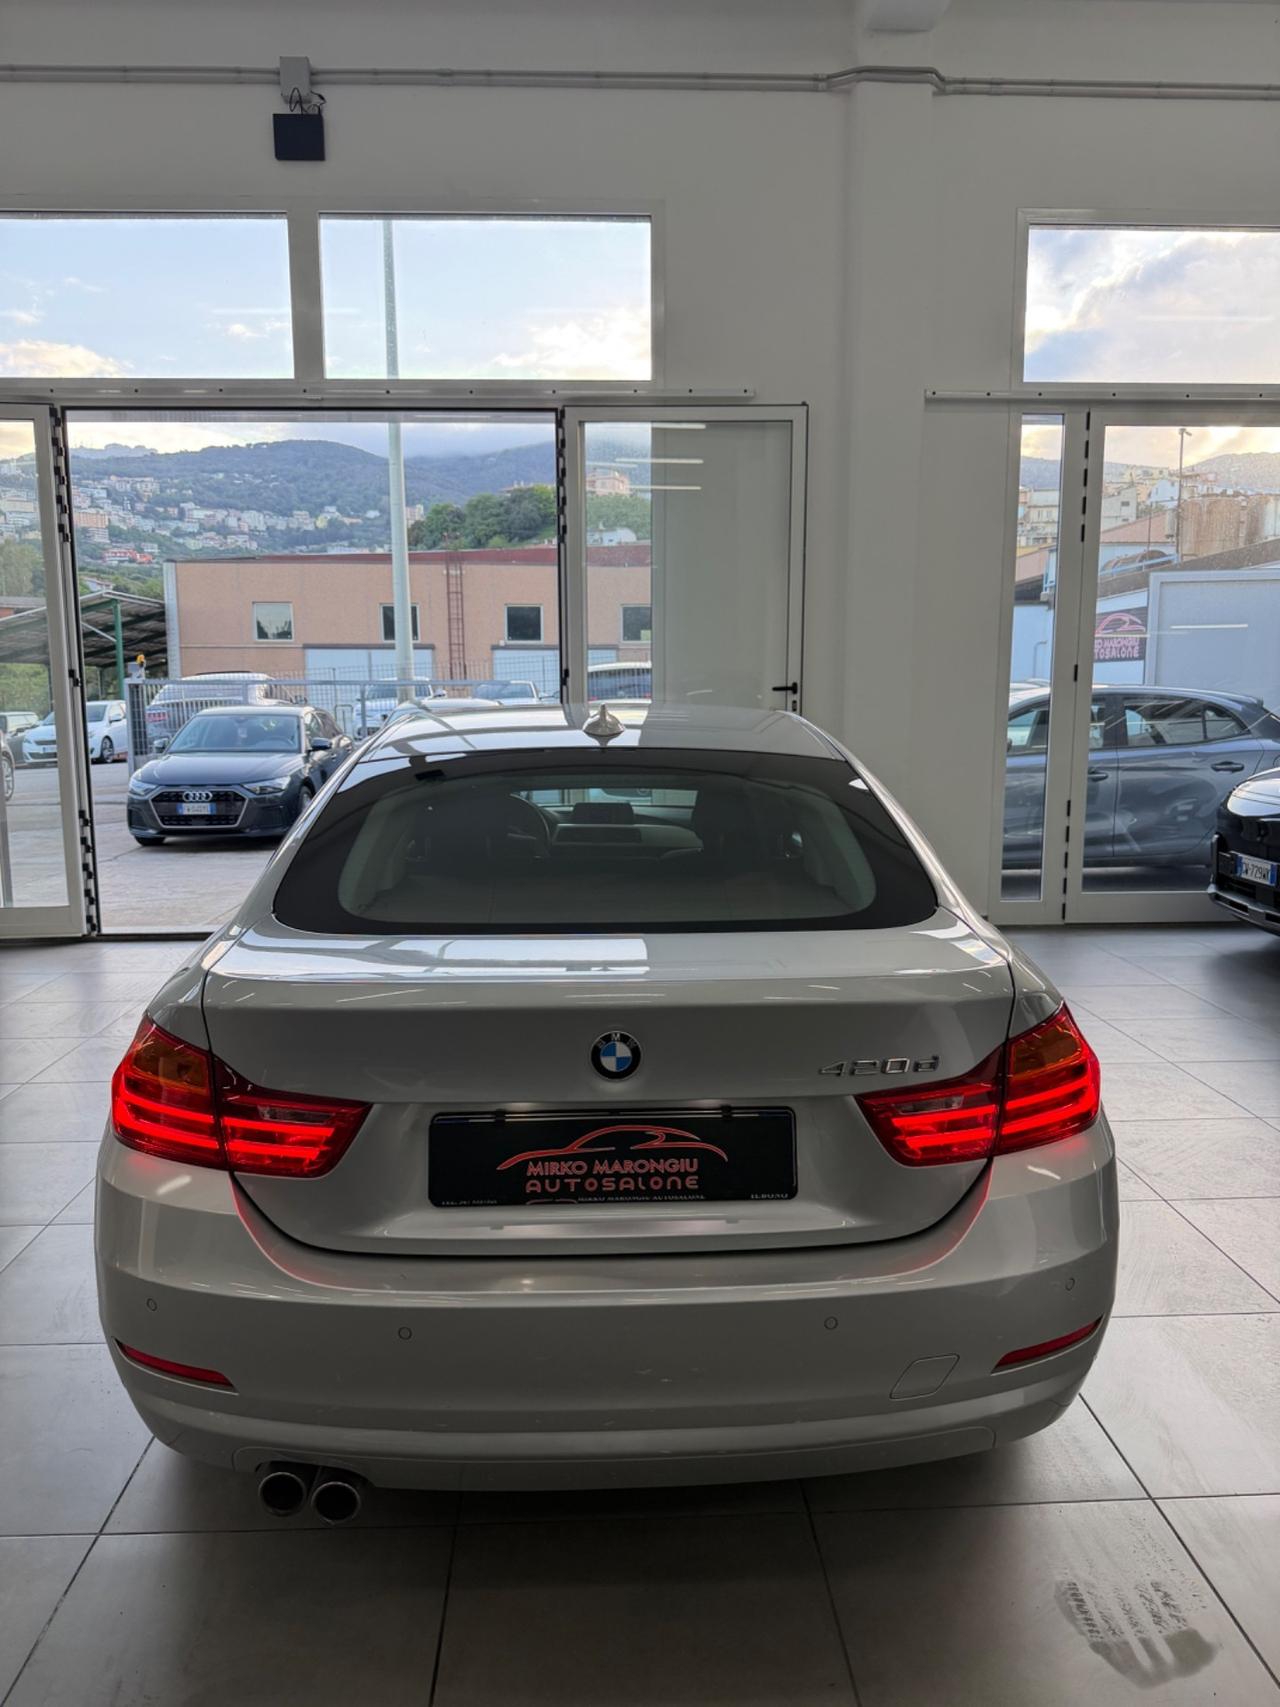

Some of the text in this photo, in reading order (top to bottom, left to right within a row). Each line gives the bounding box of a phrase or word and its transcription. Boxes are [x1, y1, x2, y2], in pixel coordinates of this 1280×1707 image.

[1094, 645, 1139, 659] TOSALONE
[819, 1055, 939, 1076] 420d
[526, 1158, 699, 1177] MIRKO MARONGIU
[526, 1175, 699, 1193] AUTOSALONE
